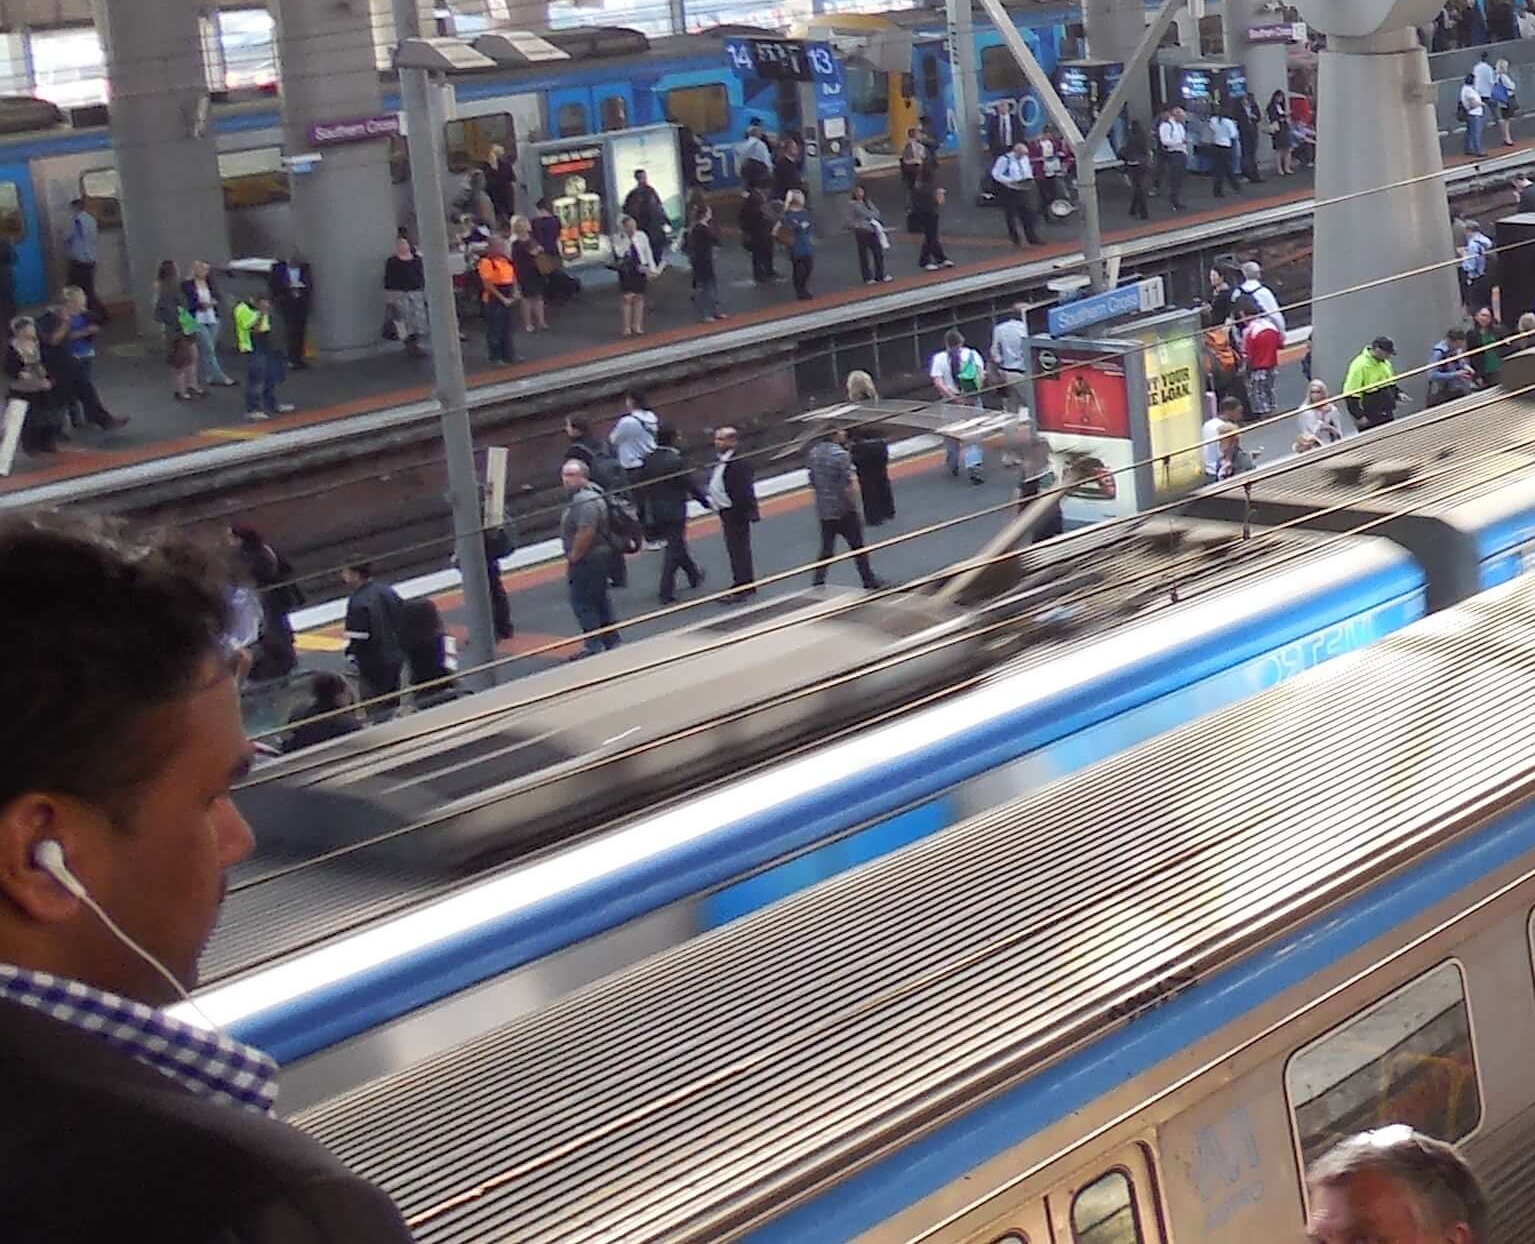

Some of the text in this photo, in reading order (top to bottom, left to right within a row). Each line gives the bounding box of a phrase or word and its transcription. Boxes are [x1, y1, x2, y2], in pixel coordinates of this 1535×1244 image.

[726, 44, 752, 69] 14
[807, 48, 833, 74] 13
[315, 123, 365, 140] Southern
[1057, 284, 1161, 329] Southern Cross 11
[1162, 367, 1190, 388] YOUR
